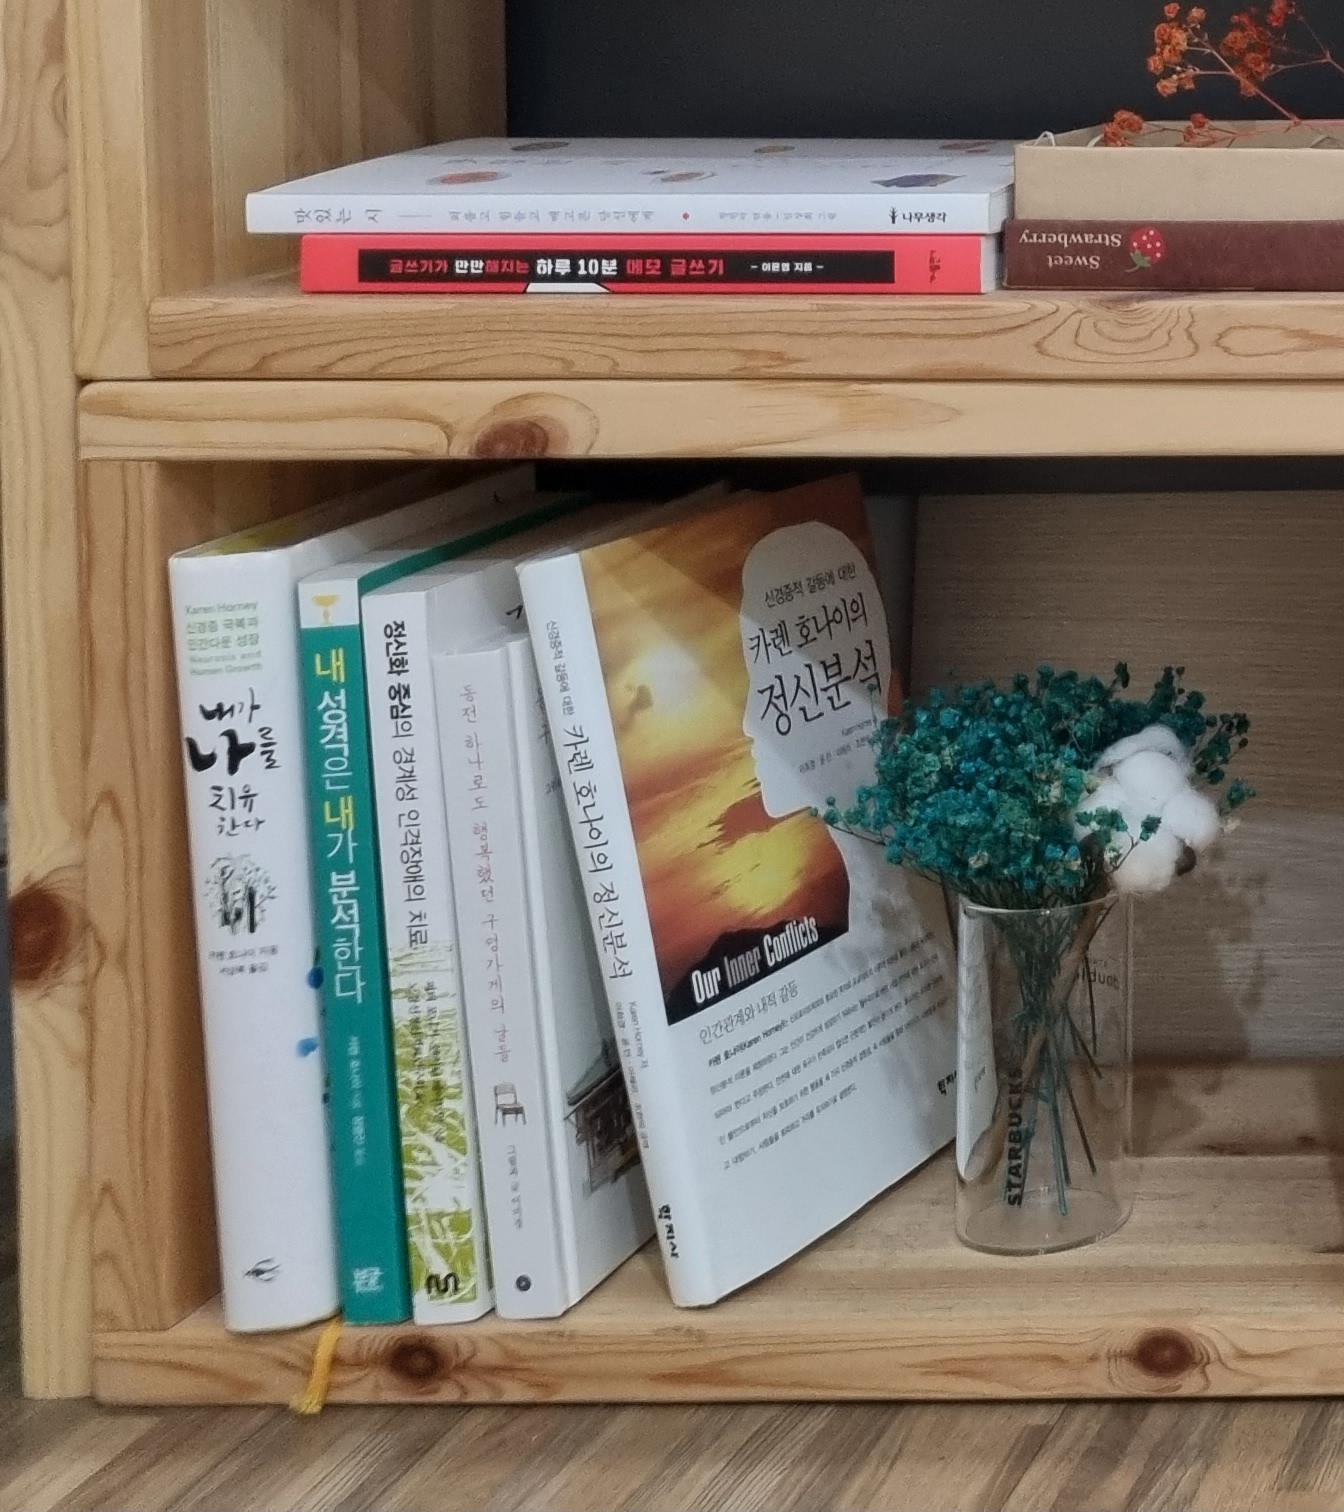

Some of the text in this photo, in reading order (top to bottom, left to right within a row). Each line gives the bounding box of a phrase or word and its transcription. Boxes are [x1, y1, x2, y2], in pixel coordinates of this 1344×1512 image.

[536, 258, 618, 276] 하루 10분
[313, 647, 346, 684] 내
[749, 592, 869, 666] 카렌 호나이의
[199, 688, 261, 724] 내가
[757, 639, 883, 736] 정신분석
[183, 727, 283, 775] 나를
[316, 689, 353, 791] 성격은
[208, 784, 260, 813] 치유
[383, 620, 429, 946] 정신화 중심의 경계성 인격장애의 치료
[323, 795, 359, 864] 내가
[564, 726, 633, 982] 카렌 호나이의 정신분석
[329, 870, 364, 1004] 분석한다
[691, 915, 820, 1005] Our Inner Conflicts
